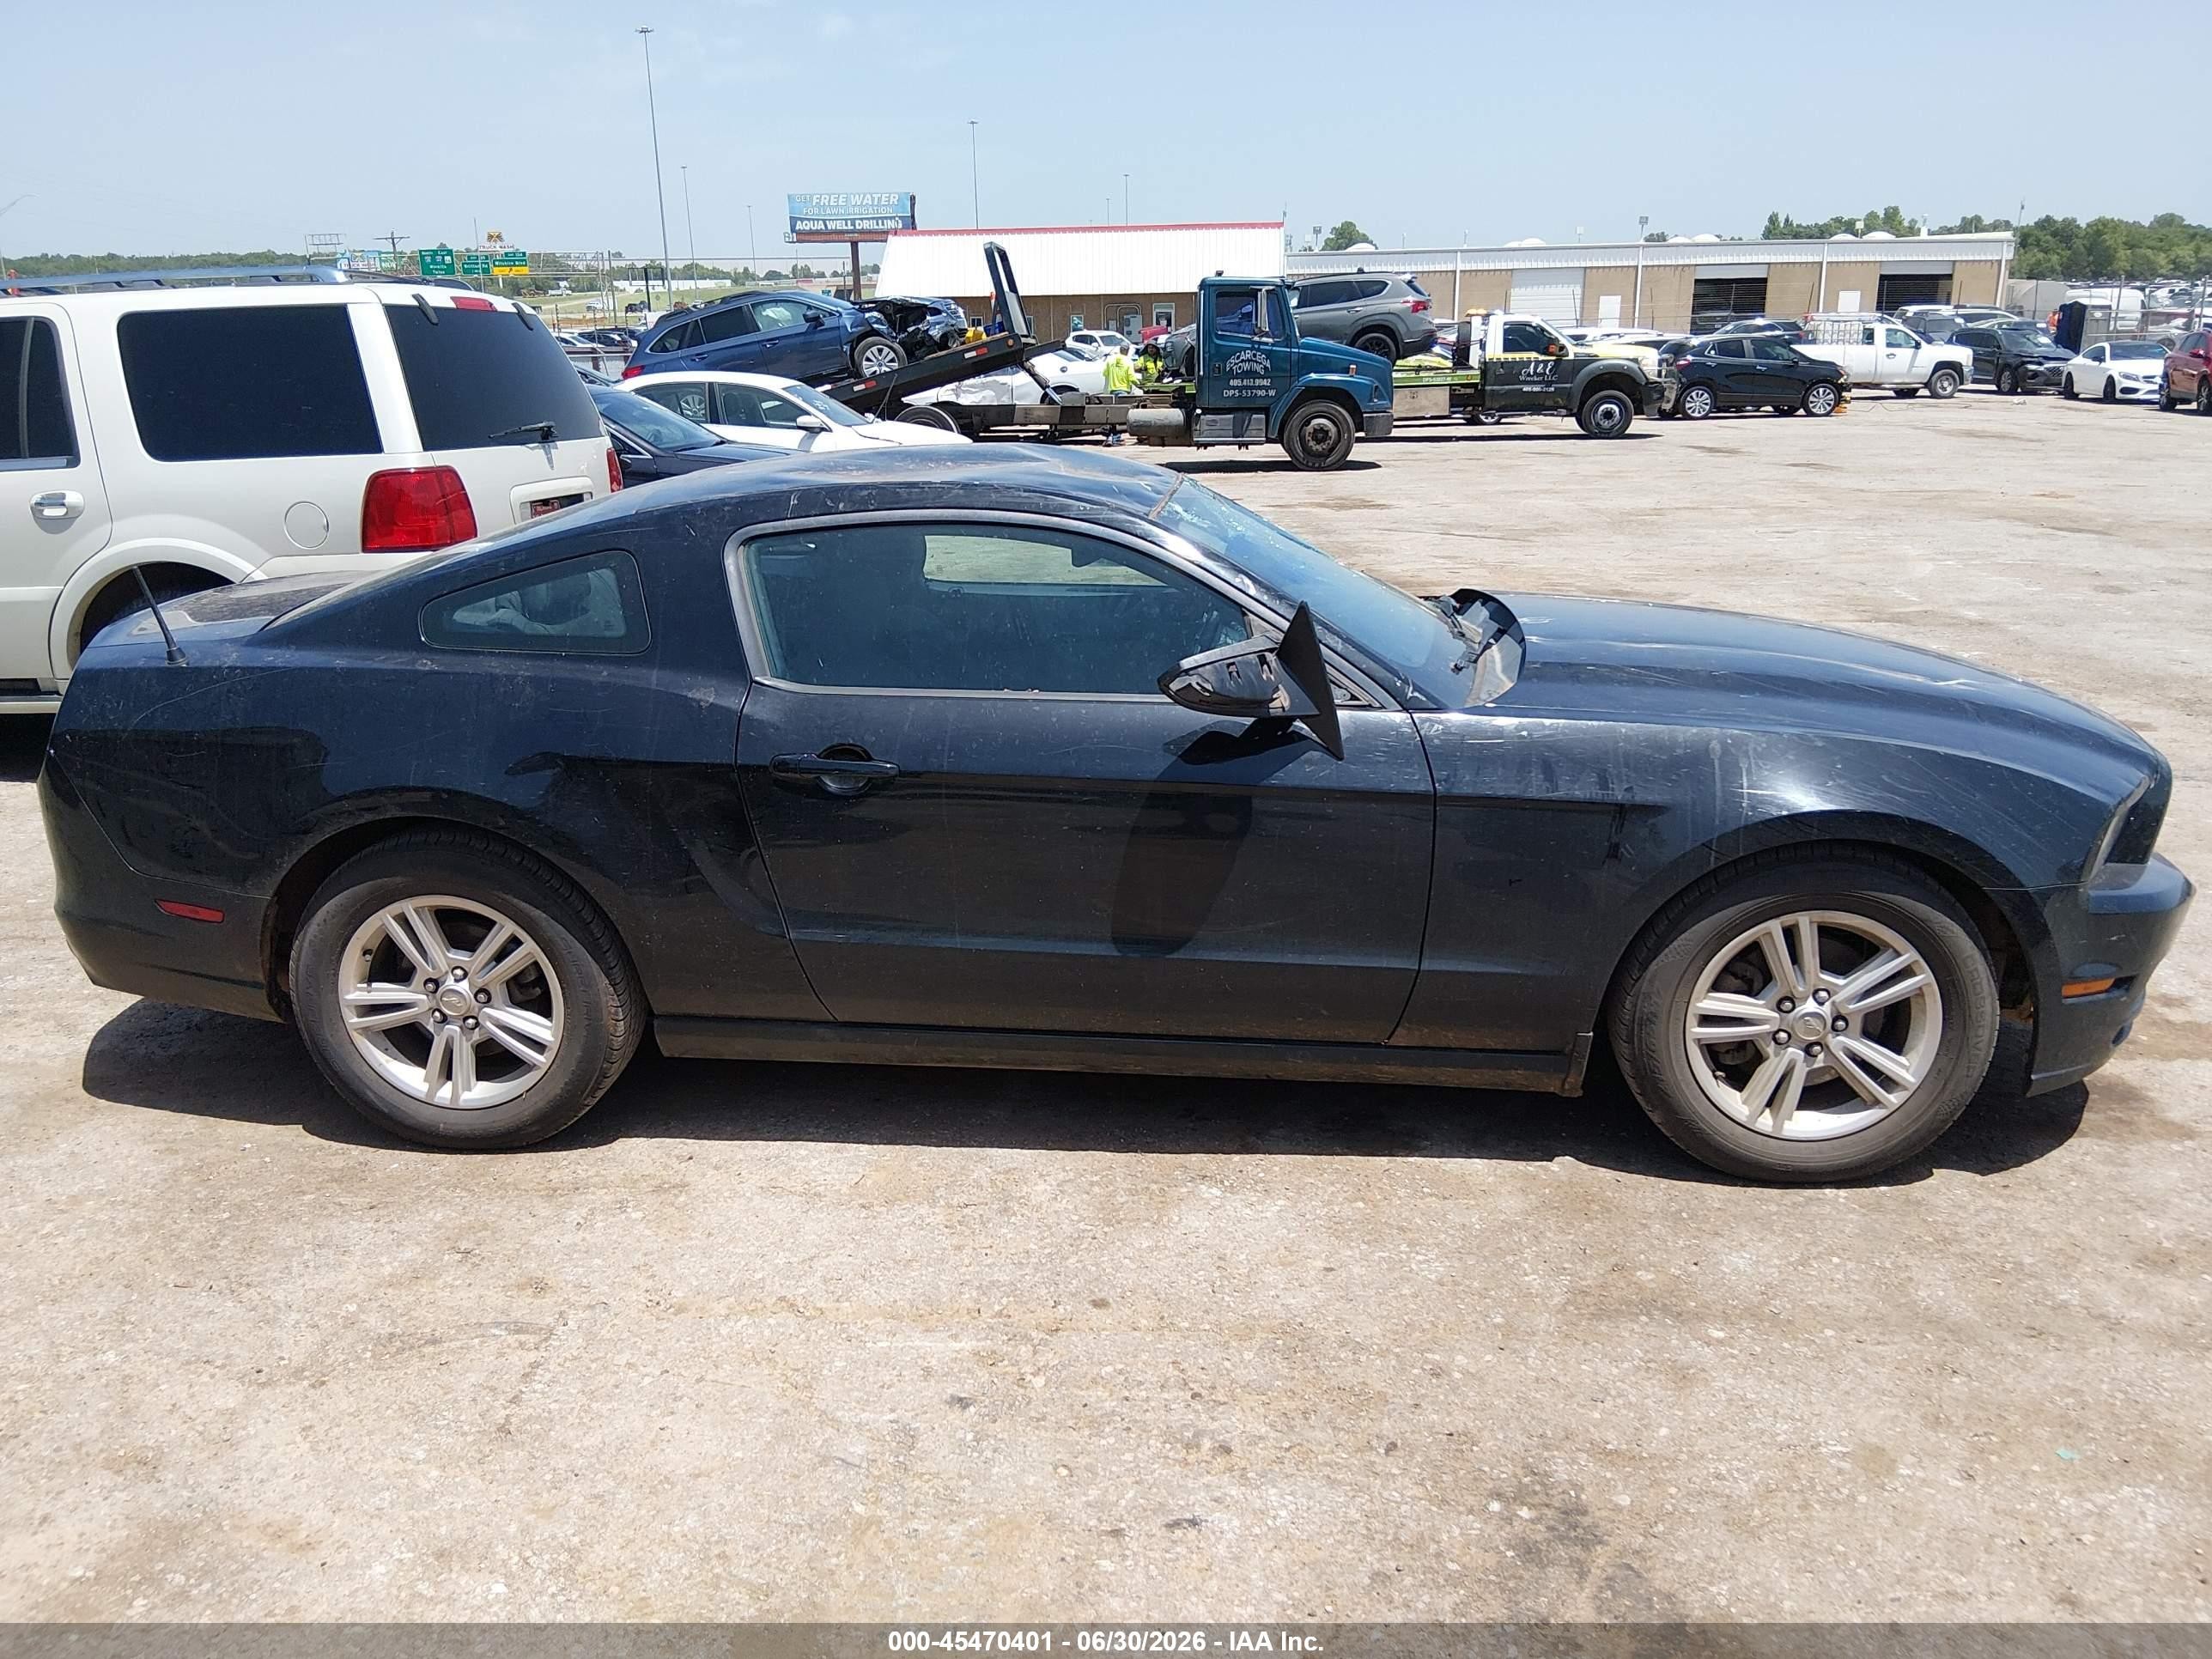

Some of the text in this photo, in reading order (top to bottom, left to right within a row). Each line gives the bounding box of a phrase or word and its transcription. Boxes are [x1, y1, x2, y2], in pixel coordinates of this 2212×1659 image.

[812, 194, 848, 206] FREE
[850, 193, 899, 205] WATER
[795, 218, 902, 230] AQUA WELL DRILLING
[1226, 349, 1271, 372] ESCARCEGA
[1232, 362, 1264, 375] TOWING
[1522, 362, 1535, 375] A
[1223, 389, 1277, 398] DPS-53790-W
